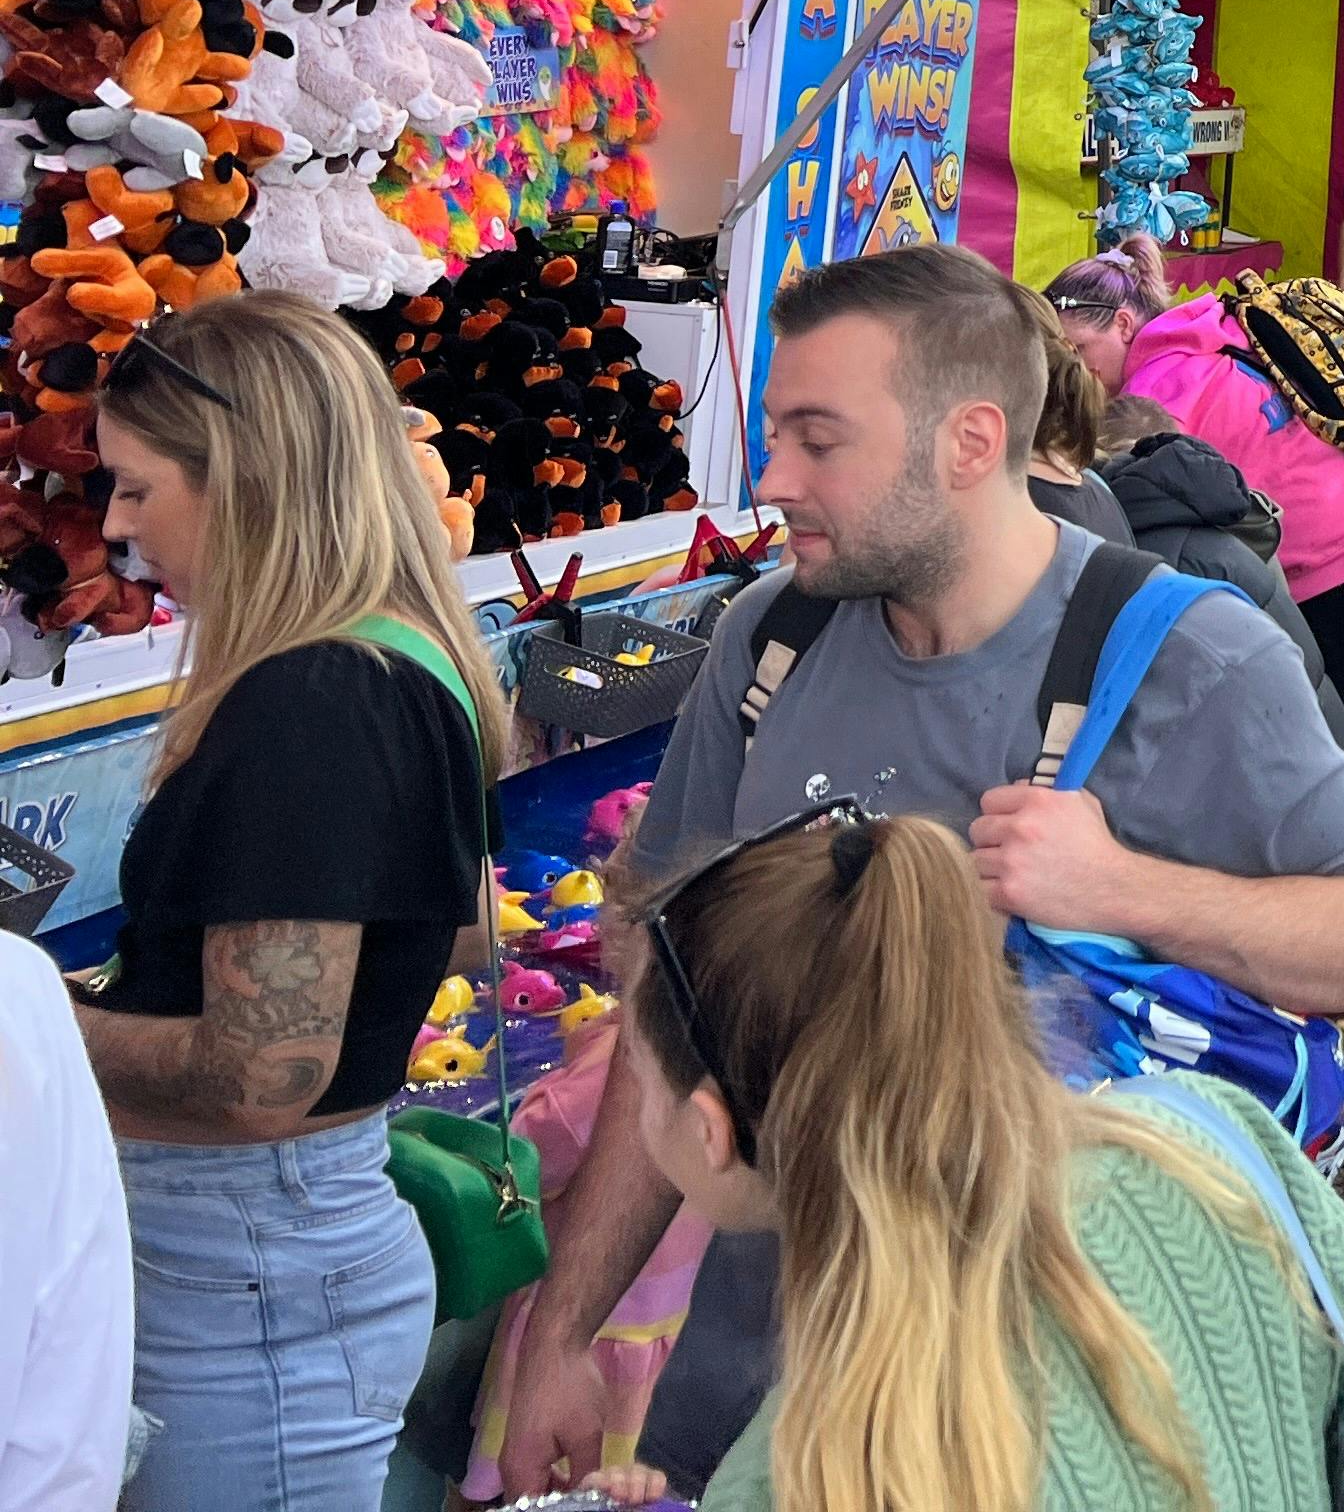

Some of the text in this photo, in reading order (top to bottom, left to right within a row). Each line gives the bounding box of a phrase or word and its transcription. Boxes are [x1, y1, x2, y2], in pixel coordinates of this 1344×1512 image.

[489, 35, 530, 57] EVERY
[486, 56, 537, 80] PLAYER
[496, 81, 532, 103] WINS
[868, 67, 958, 130] WINS!
[1193, 119, 1222, 143] WRONG
